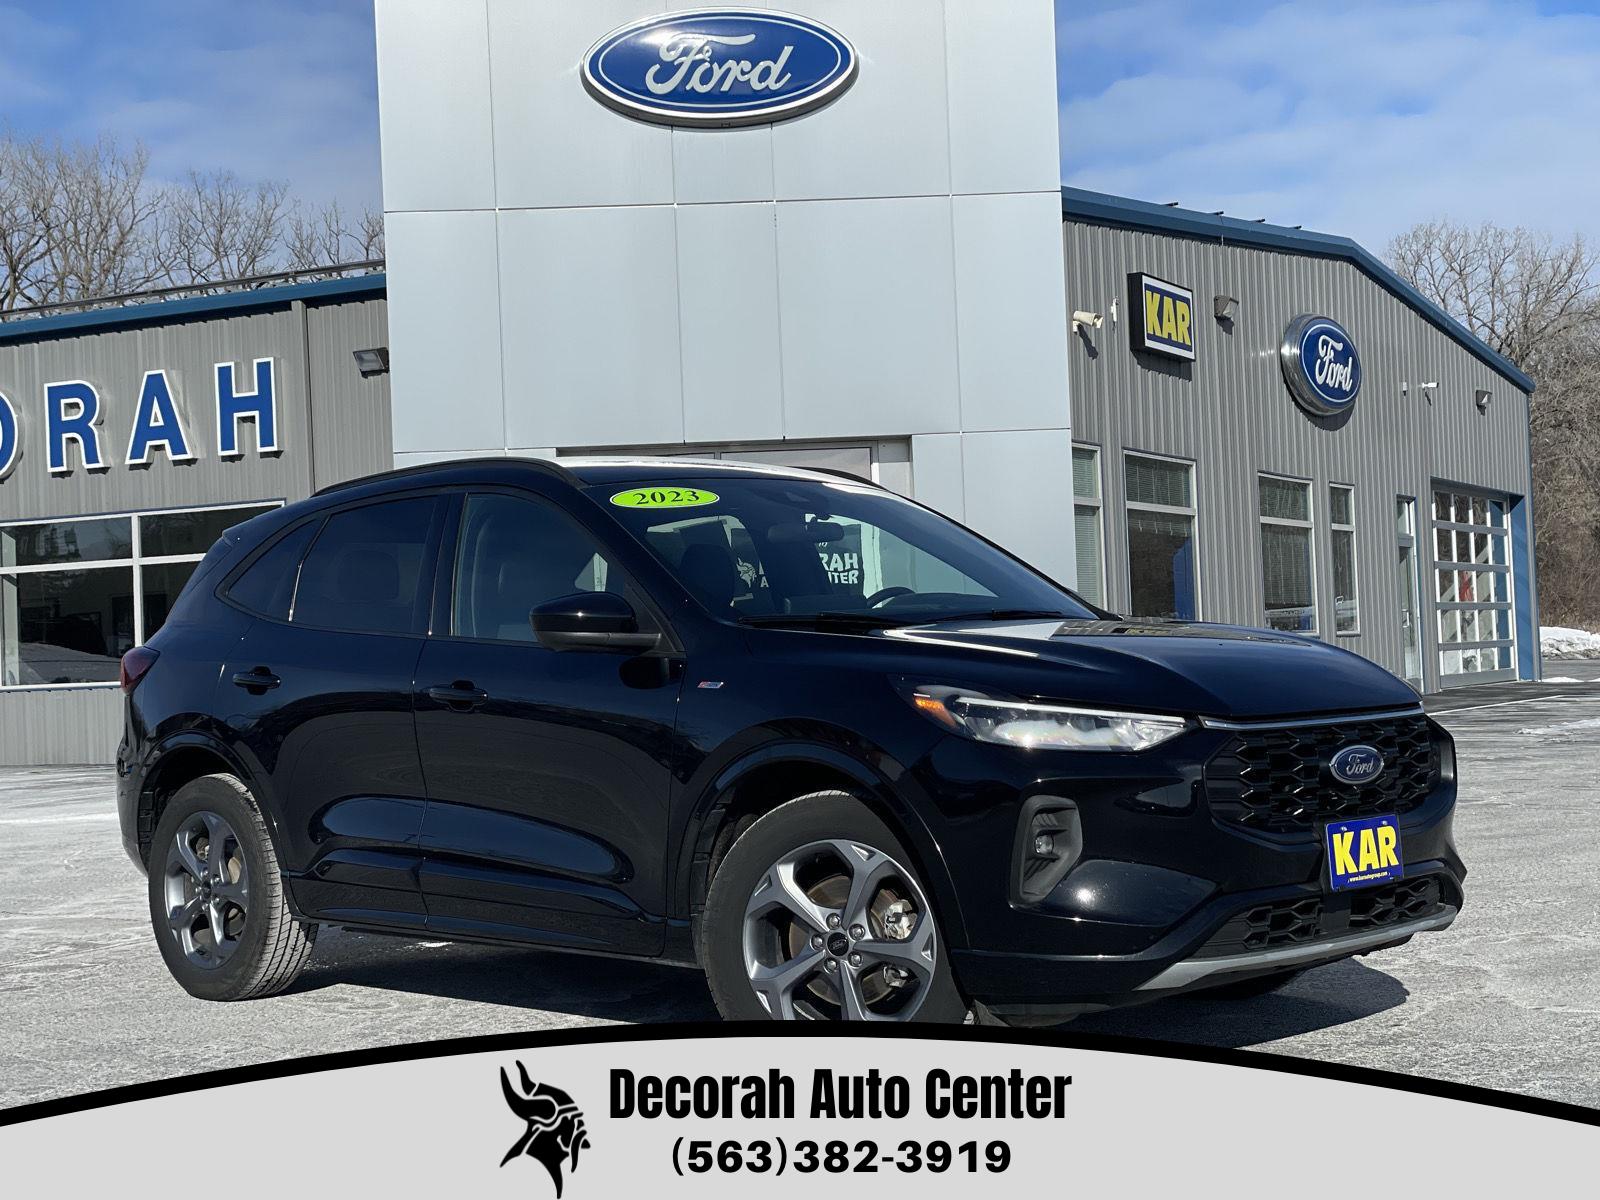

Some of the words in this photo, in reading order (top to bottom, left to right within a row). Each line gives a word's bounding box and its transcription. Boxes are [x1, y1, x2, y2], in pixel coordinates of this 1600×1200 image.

[645, 32, 794, 95] Ford
[1145, 290, 1192, 346] KAR
[1315, 334, 1353, 392] Ford
[633, 490, 700, 505] 2023
[1346, 753, 1374, 775] Ford
[1332, 825, 1400, 876] KAR
